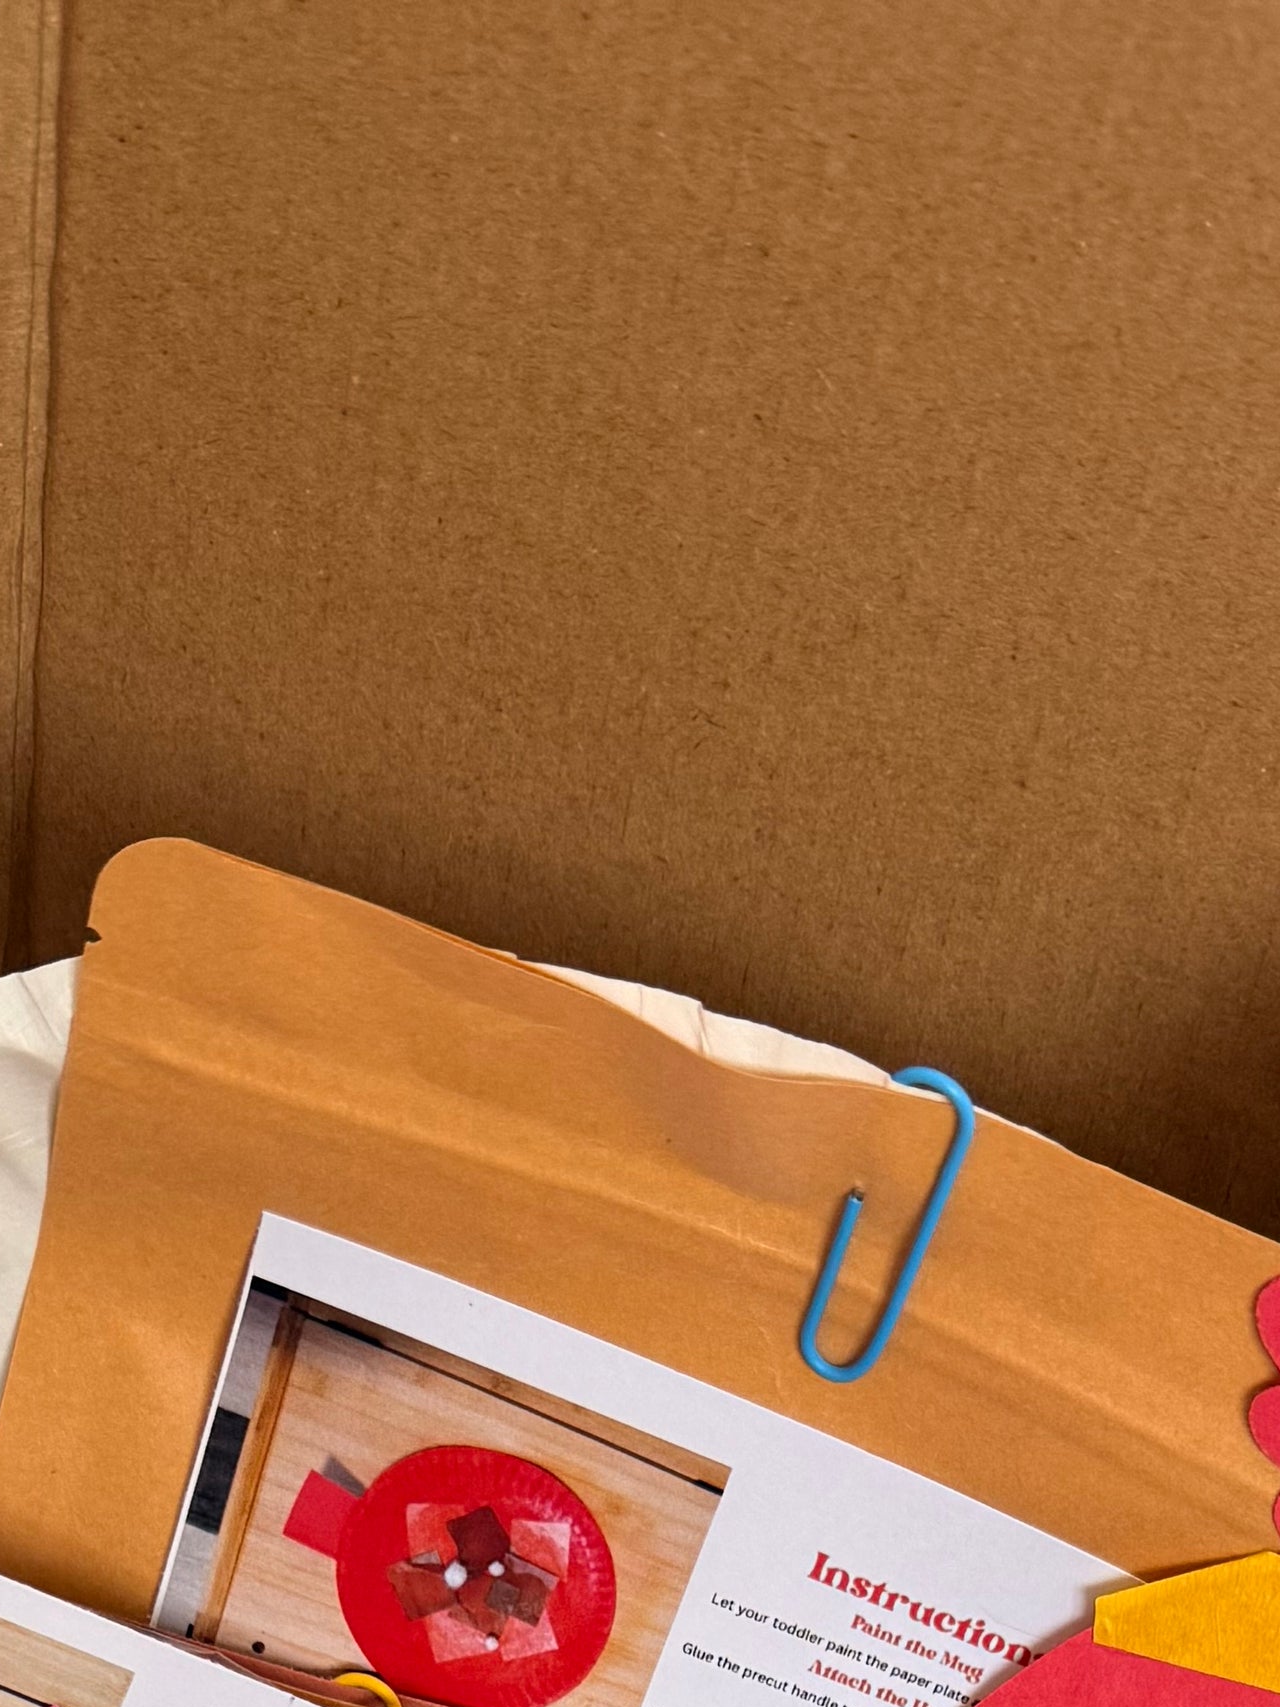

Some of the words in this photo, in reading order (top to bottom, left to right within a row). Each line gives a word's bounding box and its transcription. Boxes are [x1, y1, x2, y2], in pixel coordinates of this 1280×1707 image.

[807, 1551, 1041, 1667] Instruction
[682, 1642, 715, 1663] Glue
[716, 1656, 741, 1674] the
[741, 1667, 789, 1693] precut
[711, 1592, 735, 1612] Let
[735, 1604, 770, 1624] your
[772, 1617, 825, 1646] toddler
[824, 1640, 863, 1663] paint
[865, 1654, 889, 1672] the
[889, 1666, 933, 1689] paper
[932, 1683, 970, 1705] plate
[807, 1659, 872, 1696] Attach
[875, 1687, 908, 1707] the
[850, 1614, 902, 1647] Paint
[904, 1639, 938, 1660] the
[939, 1650, 984, 1684] Mug
